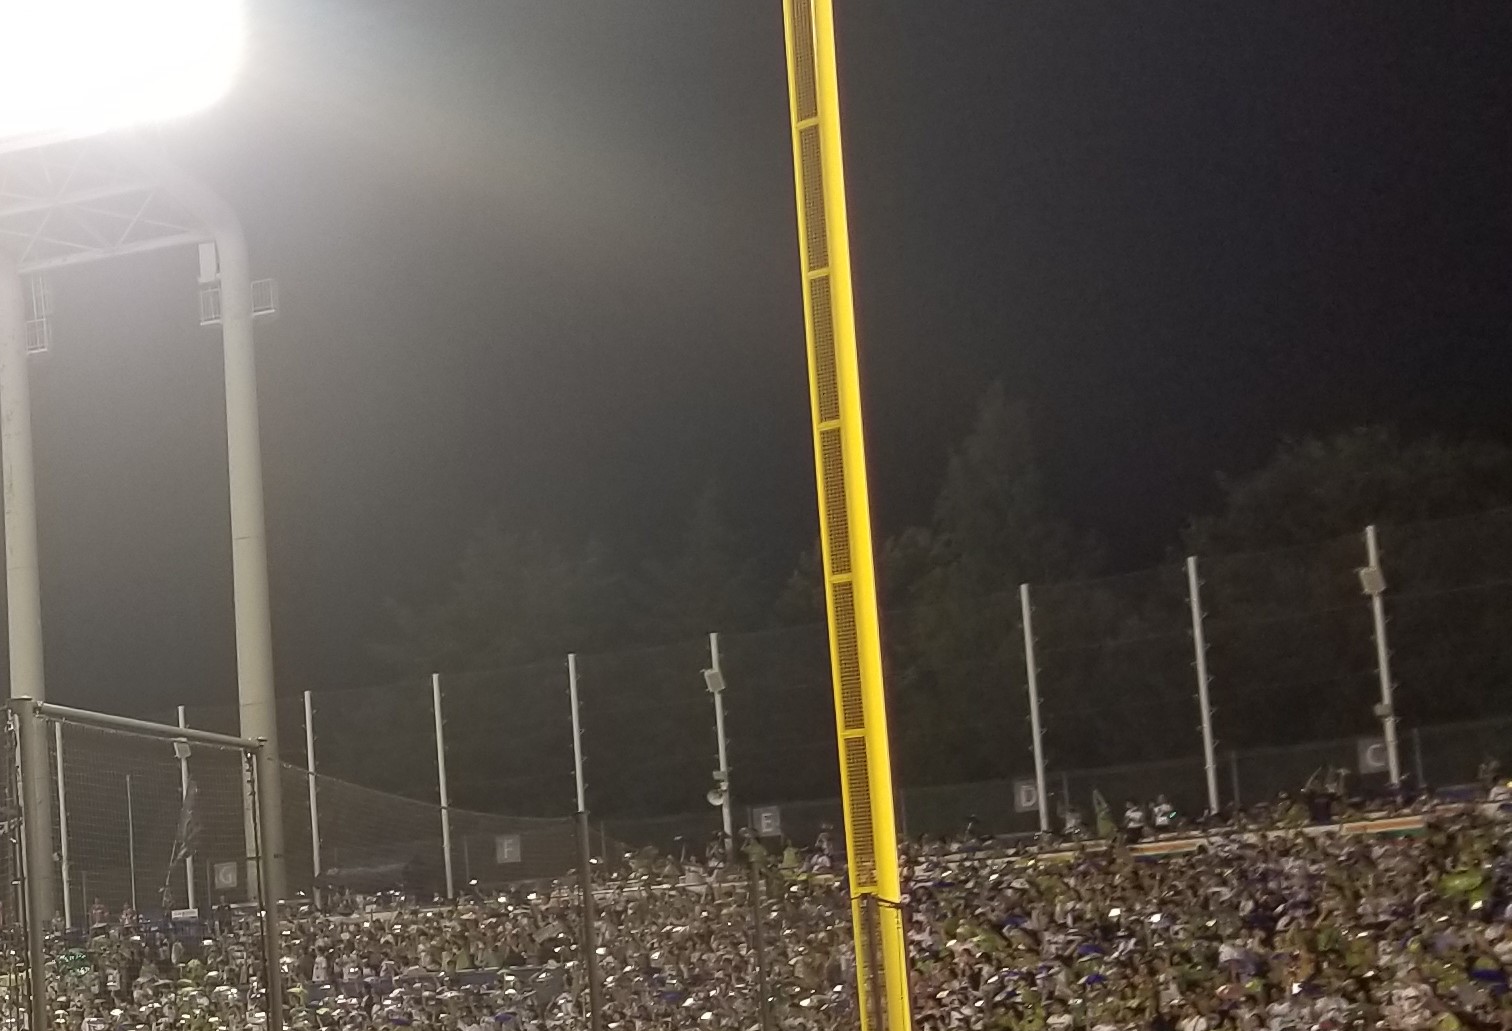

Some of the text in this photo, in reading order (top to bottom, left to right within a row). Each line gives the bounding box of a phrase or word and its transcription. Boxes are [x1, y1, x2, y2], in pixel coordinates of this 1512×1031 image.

[761, 813, 773, 832] E
[503, 839, 513, 858] F
[219, 867, 232, 884] G
